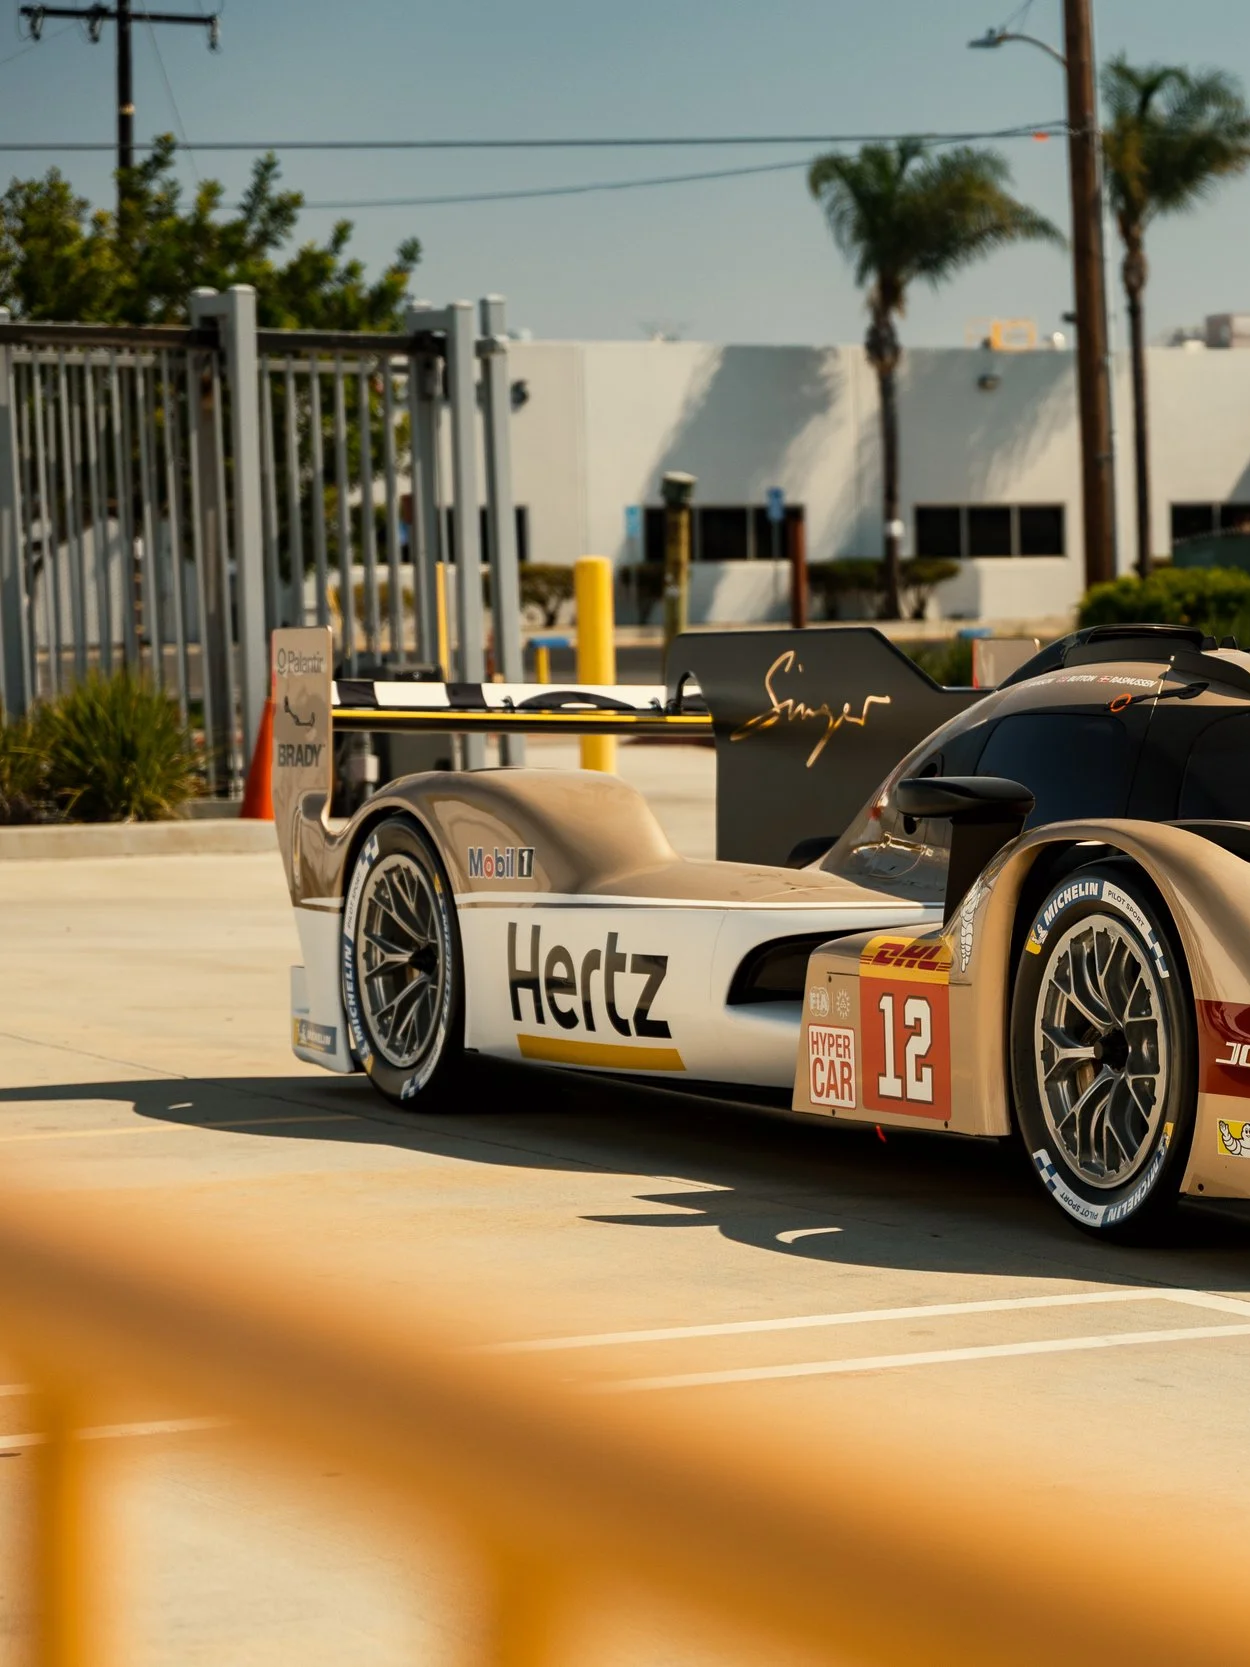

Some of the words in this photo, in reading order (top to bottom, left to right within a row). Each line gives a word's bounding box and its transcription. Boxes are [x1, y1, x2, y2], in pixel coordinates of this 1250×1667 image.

[288, 651, 325, 673] Palantir
[730, 650, 891, 768] Singer
[278, 743, 322, 768] BRADY
[468, 848, 515, 879] Mobil
[519, 850, 531, 877] 1
[1043, 882, 1099, 926] MICHELIN
[1107, 889, 1126, 906] PILOT
[1126, 901, 1146, 928] SPORT
[871, 942, 943, 971] DHL
[343, 944, 363, 1042] MICHELIN
[507, 921, 673, 1040] Hertz
[809, 991, 829, 1011] FIA
[811, 1031, 851, 1059] HYPER
[877, 992, 934, 1105] 12
[812, 1057, 853, 1101] CAR
[1059, 1192, 1081, 1213] SPORT
[1107, 1158, 1159, 1223] MICHELIN
[1079, 1207, 1099, 1221] PILOT
